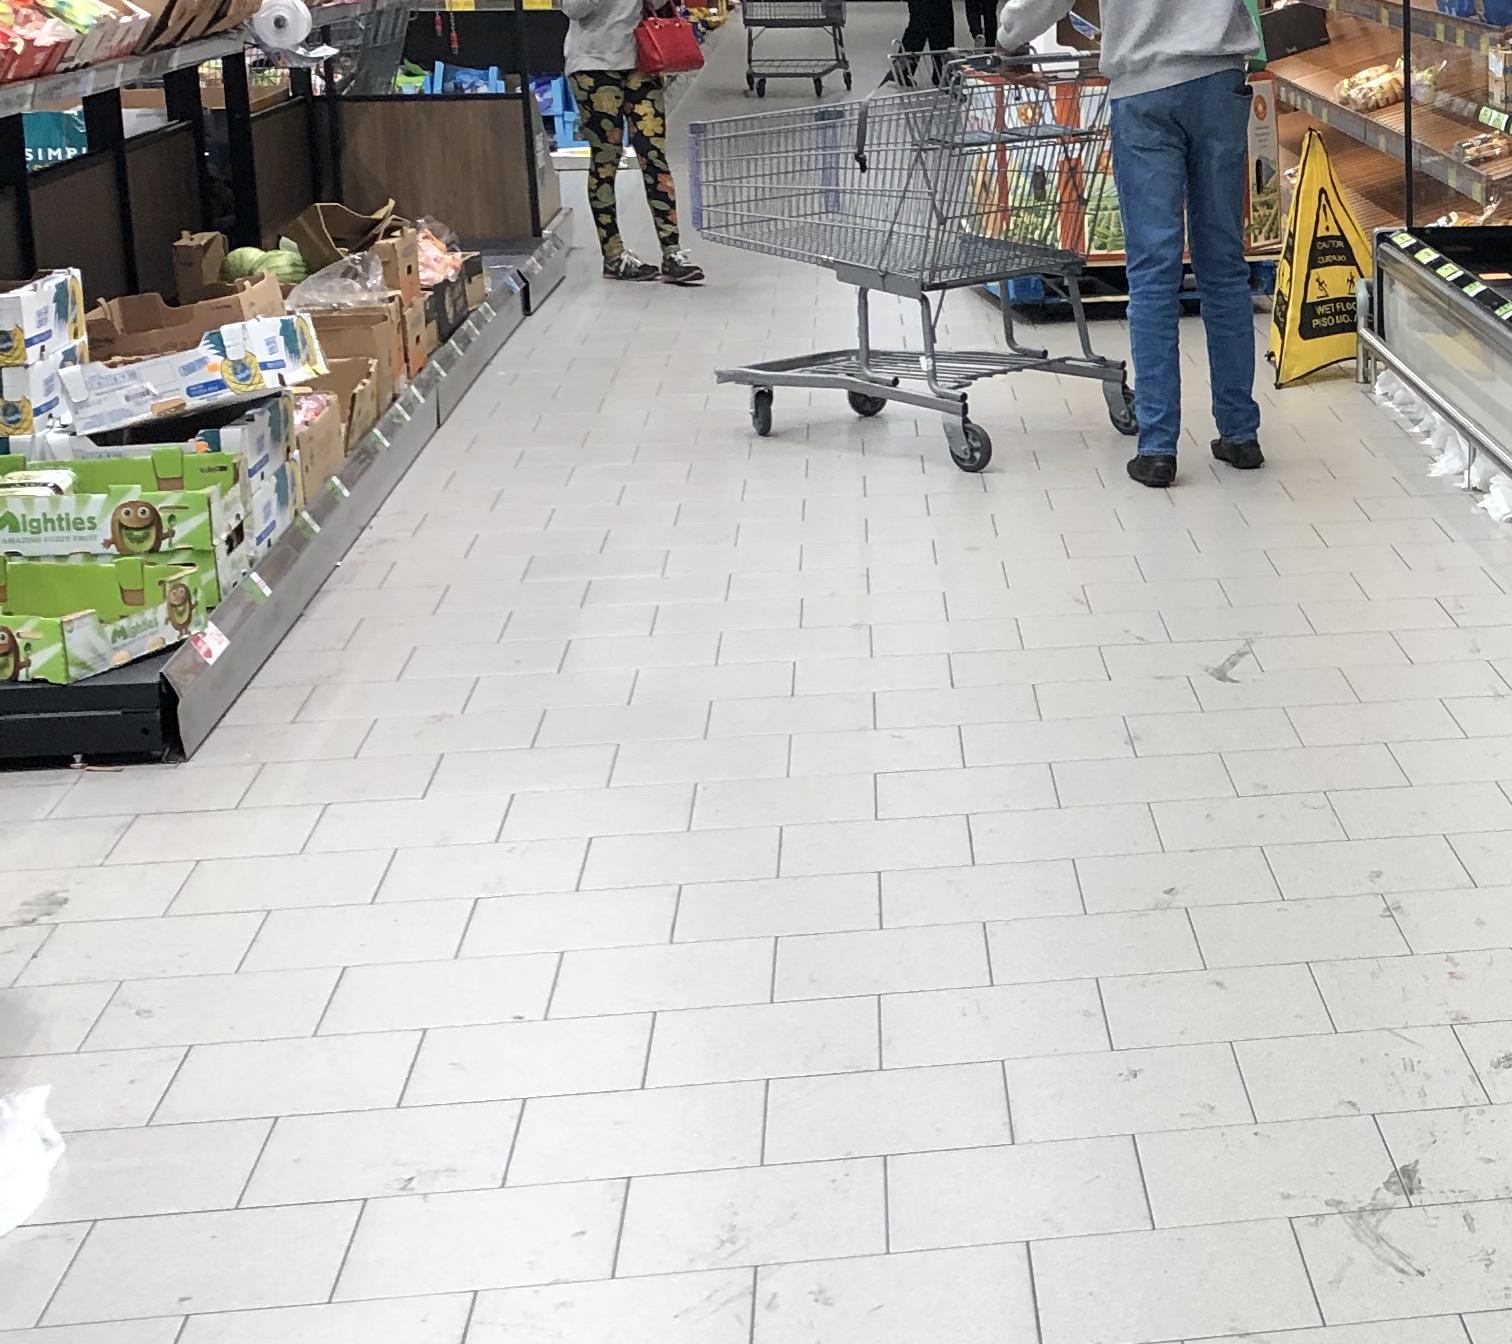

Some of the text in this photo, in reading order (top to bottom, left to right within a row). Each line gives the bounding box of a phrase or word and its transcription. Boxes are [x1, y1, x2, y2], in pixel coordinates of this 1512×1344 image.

[1315, 303, 1335, 315] WET
[1312, 317, 1335, 329] PISO
[0, 509, 98, 535] Mighties
